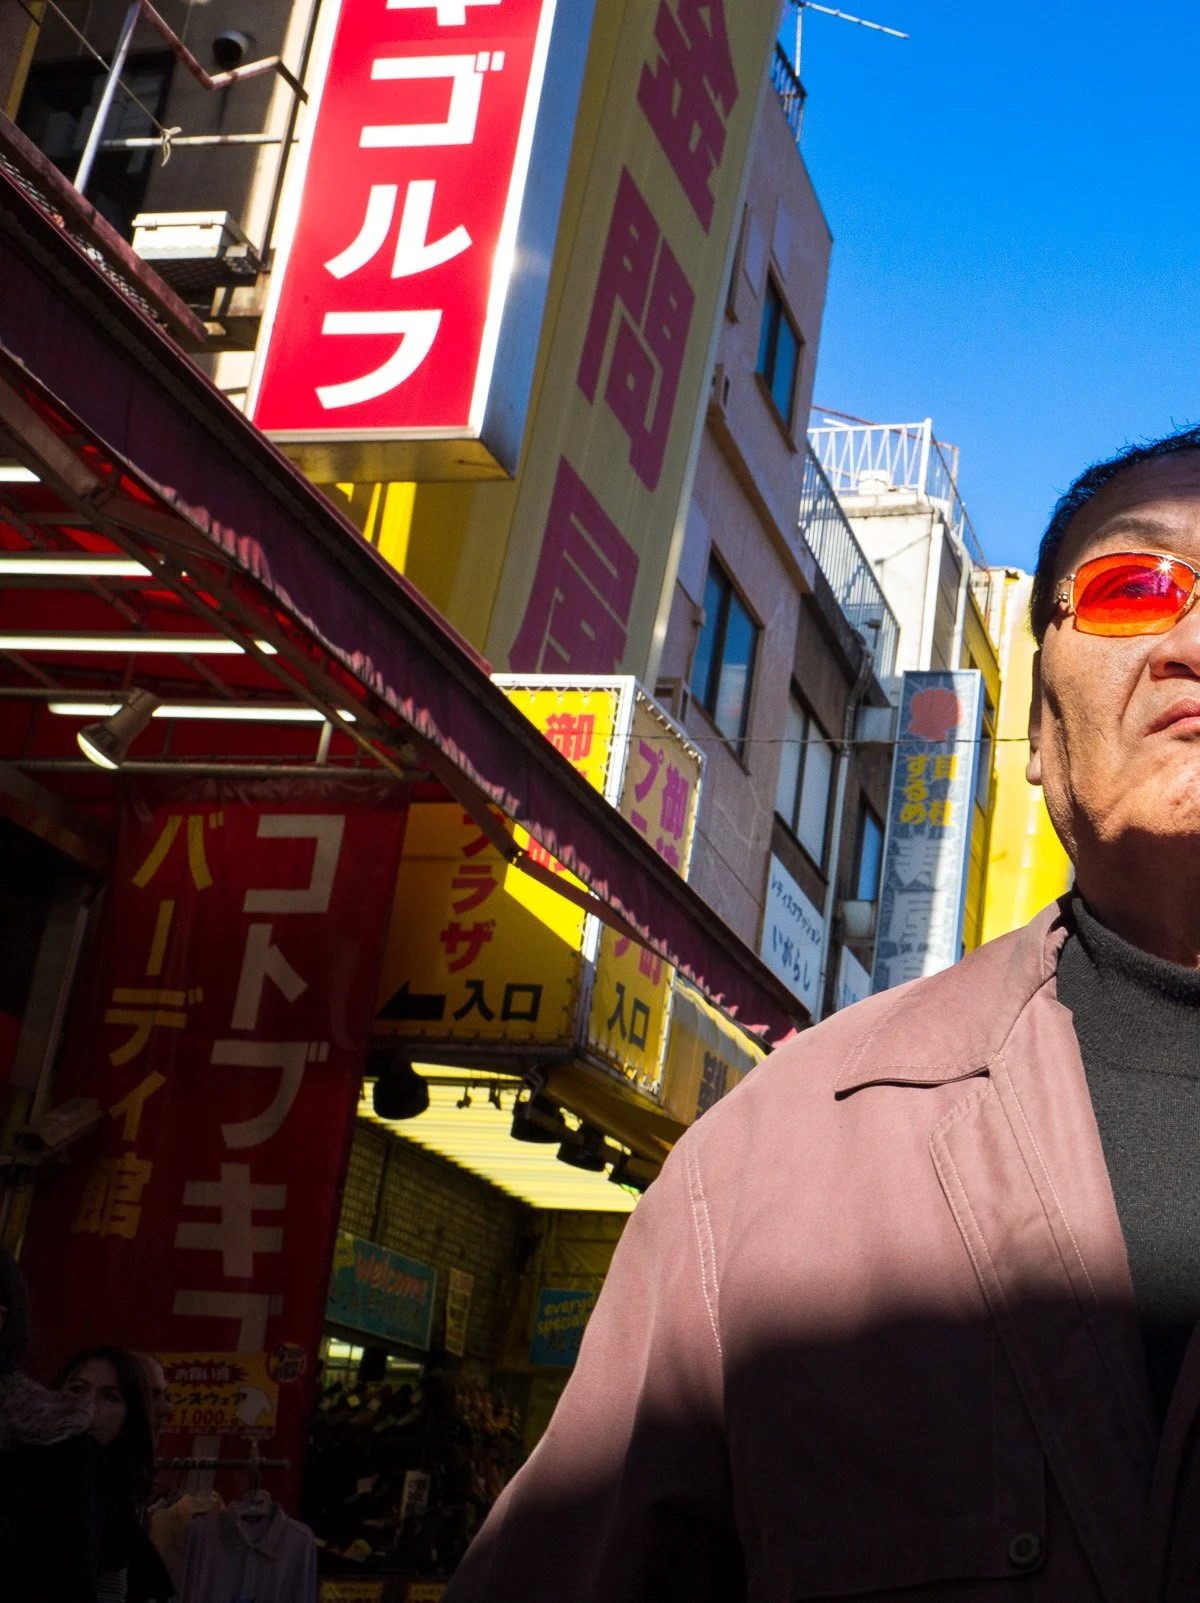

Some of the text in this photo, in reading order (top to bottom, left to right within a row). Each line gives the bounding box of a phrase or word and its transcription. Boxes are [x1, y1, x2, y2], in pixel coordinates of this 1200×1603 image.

[453, 979, 543, 1022] 入口
[608, 981, 650, 1050] 入口
[171, 813, 347, 1495] コトブキゴ
